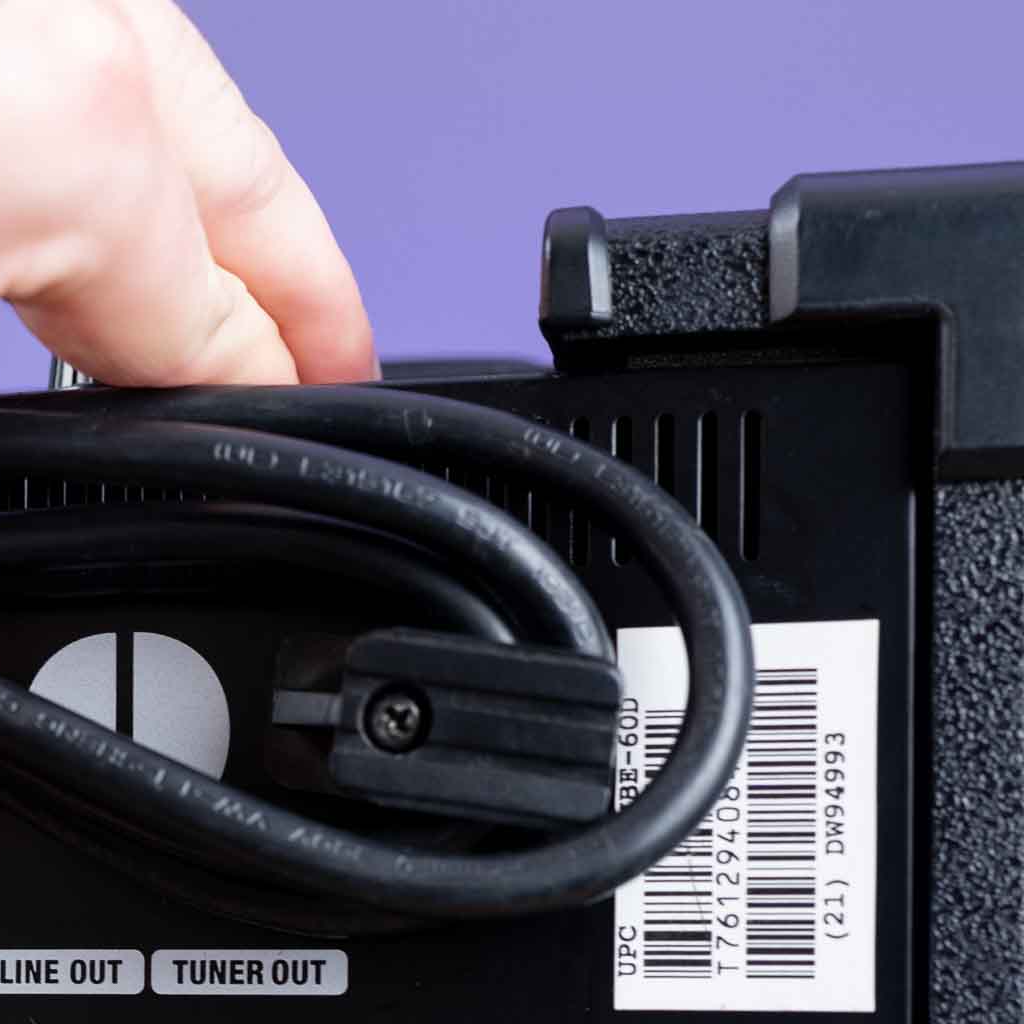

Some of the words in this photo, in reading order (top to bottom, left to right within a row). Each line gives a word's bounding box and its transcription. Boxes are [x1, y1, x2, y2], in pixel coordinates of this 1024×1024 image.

[825, 731, 846, 855] DW94993
[715, 766, 741, 949] 76129408
[824, 879, 849, 940] (21)
[0, 959, 58, 984] LINE
[69, 959, 123, 985] OUT
[172, 959, 263, 984] TUNER
[271, 959, 327, 985] OUT
[618, 924, 637, 977] UPC
